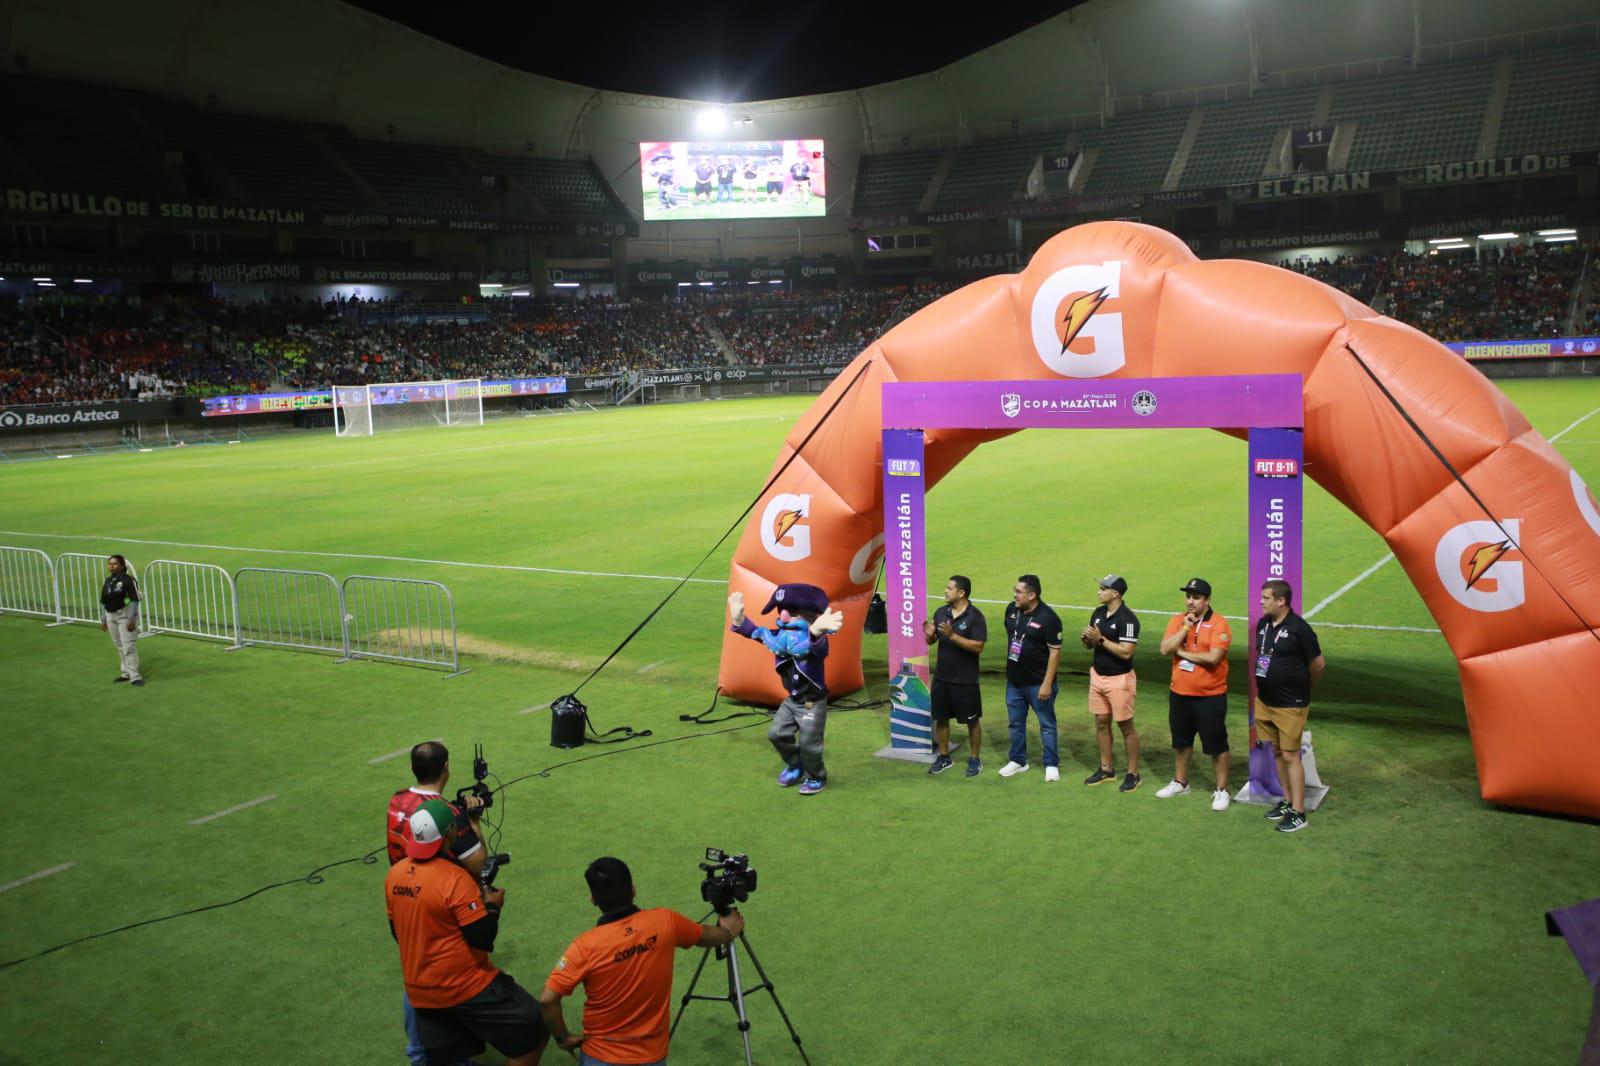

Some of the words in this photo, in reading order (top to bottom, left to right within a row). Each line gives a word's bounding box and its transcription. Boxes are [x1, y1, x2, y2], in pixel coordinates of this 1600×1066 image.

[1306, 129, 1323, 144] 11
[1055, 157, 1069, 169] 10
[1545, 155, 1570, 170] DE
[1258, 179, 1288, 199] EL
[1292, 171, 1371, 196] GRAN
[127, 201, 150, 217] DE
[160, 203, 193, 219] SER
[198, 205, 219, 219] DE
[1236, 241, 1248, 250] EL
[1250, 237, 1301, 249] ENCANTO
[1303, 230, 1380, 245] DESARROLLOS
[330, 271, 342, 281] EL
[344, 271, 388, 281] ENCANTO
[389, 271, 451, 281] DESARROLLOS
[638, 271, 673, 282] Corona
[696, 269, 729, 281] Corona
[751, 267, 785, 279] Corona
[801, 265, 836, 277] Corona
[1024, 400, 1058, 409] COPA
[26, 412, 70, 426] Banco
[73, 409, 120, 422] Azteca
[892, 461, 907, 471] FUT
[1257, 461, 1274, 472] FUT
[1266, 498, 1285, 582] azatlán
[897, 493, 915, 638] #CopaMazatlán
